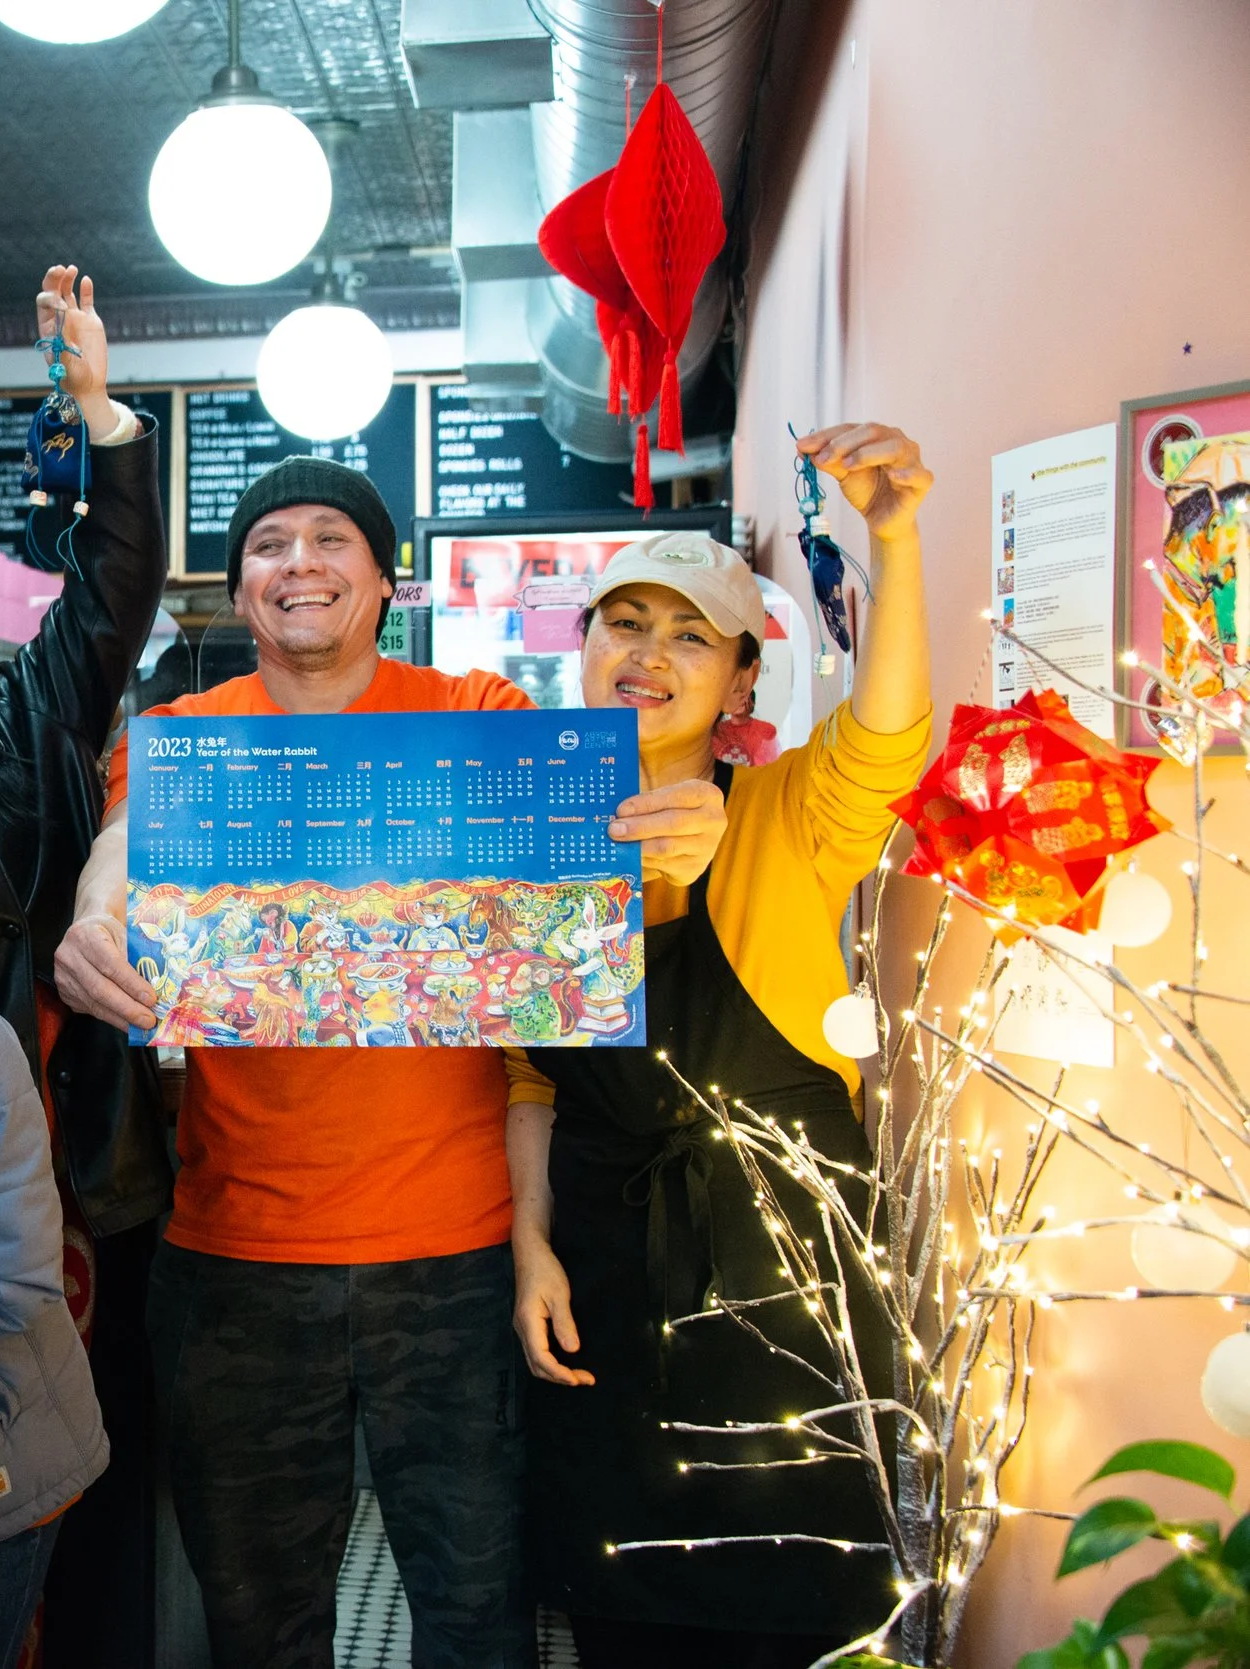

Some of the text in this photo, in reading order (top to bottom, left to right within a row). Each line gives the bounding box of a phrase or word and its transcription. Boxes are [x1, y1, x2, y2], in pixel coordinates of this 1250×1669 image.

[393, 586, 423, 602] ORS
[380, 634, 404, 650] $15
[196, 736, 227, 748] 水兔年
[148, 737, 192, 757] 2023
[196, 746, 318, 757] Year of the Water Rabbit
[149, 764, 179, 772] January
[227, 764, 258, 772] February
[386, 762, 402, 770] April
[148, 822, 164, 830] July
[227, 820, 252, 828] August
[306, 820, 345, 828] September
[187, 884, 238, 917] CHINATOWN
[244, 892, 276, 905] WITH
[282, 882, 305, 900] LOVE
